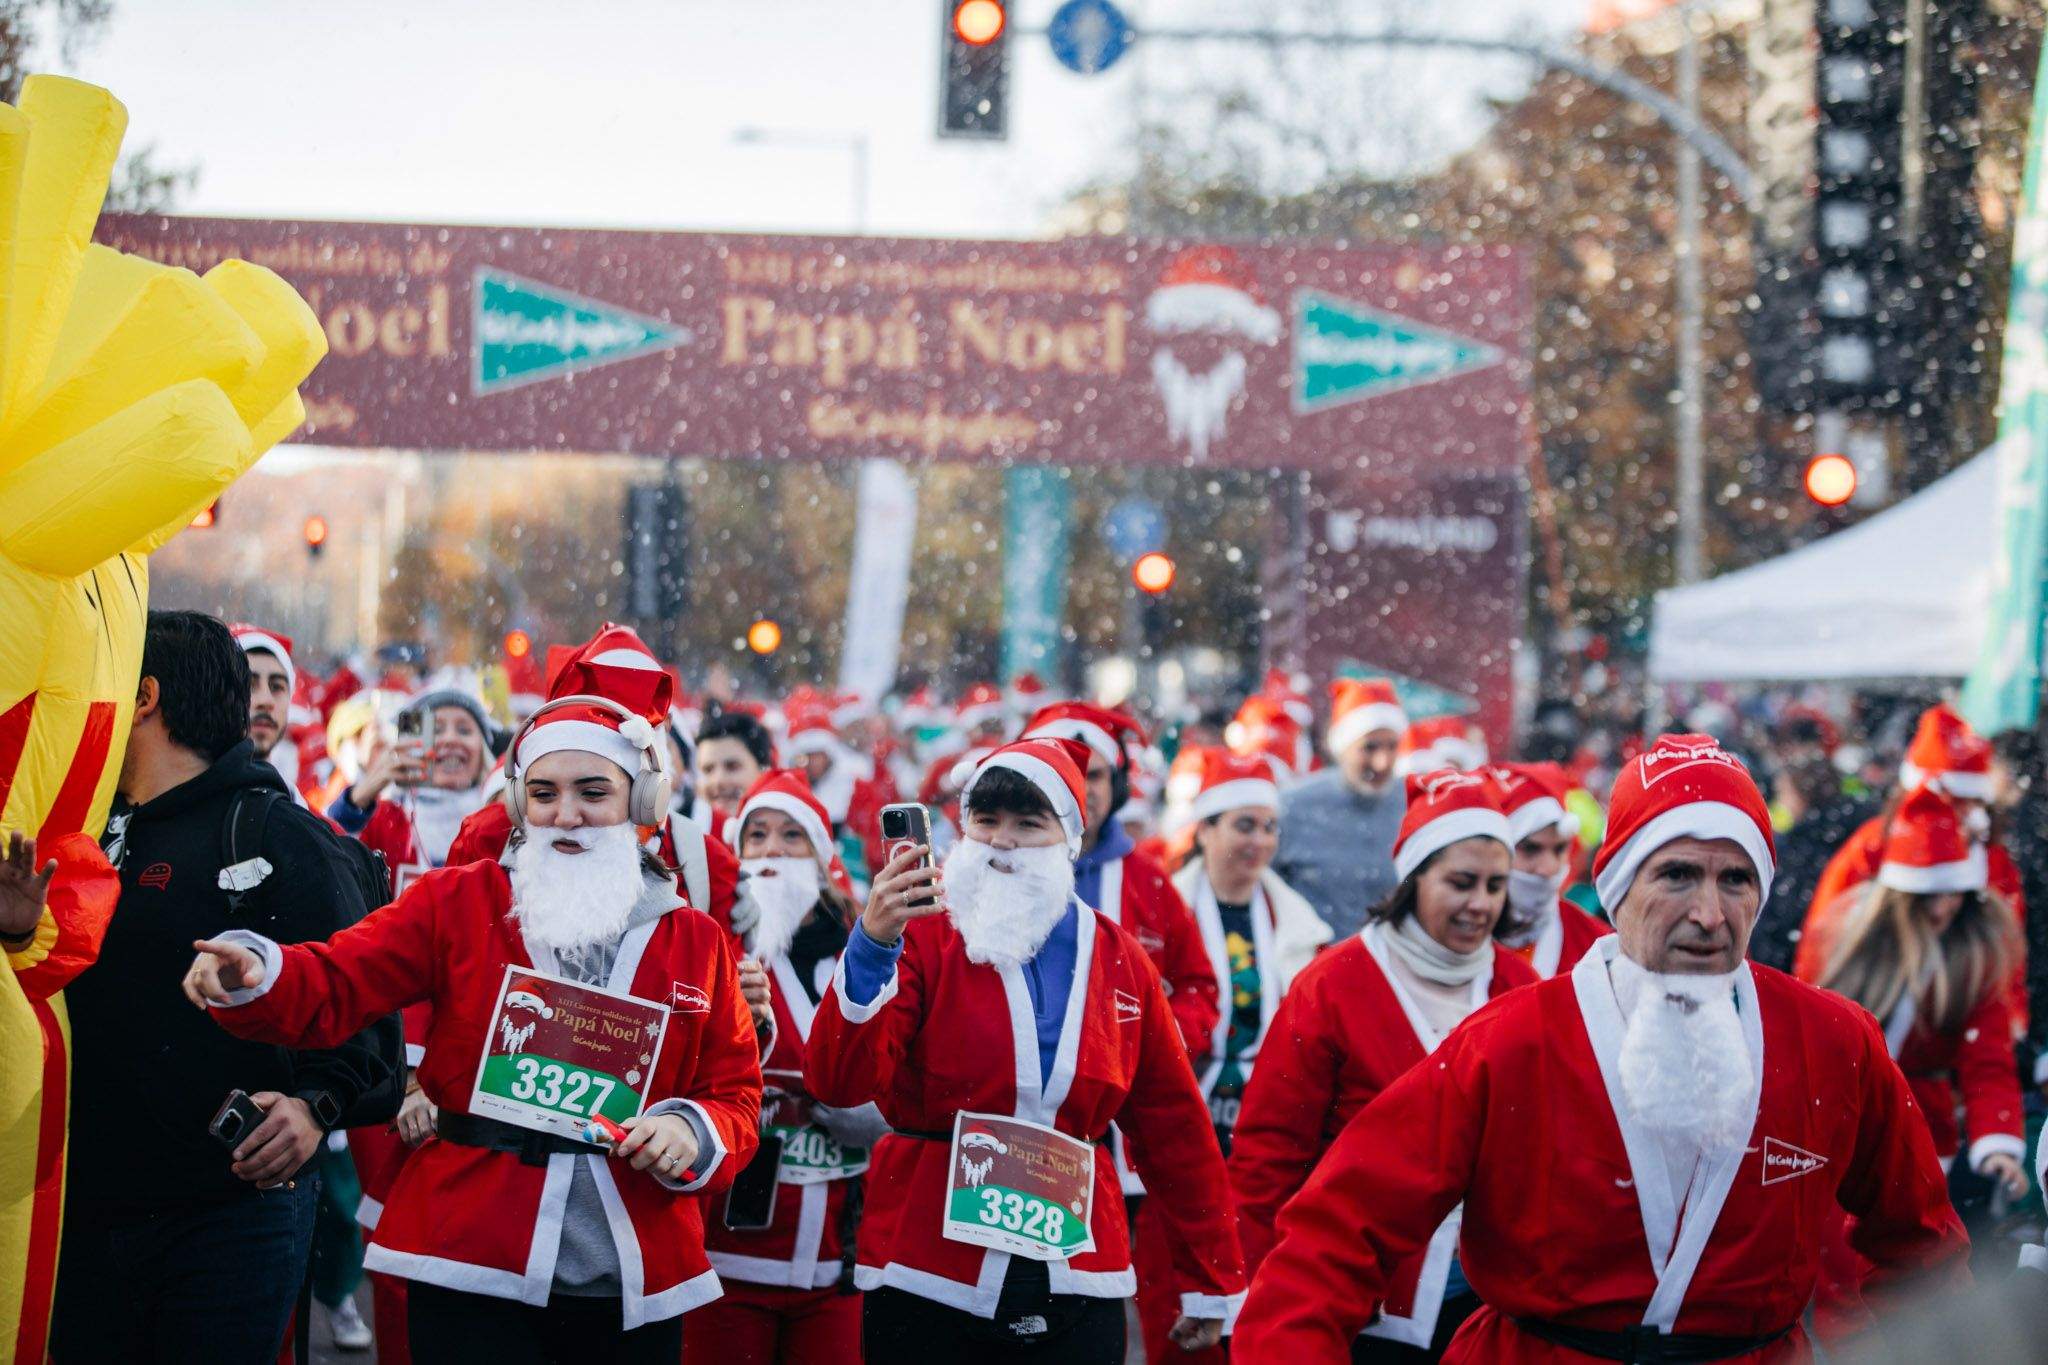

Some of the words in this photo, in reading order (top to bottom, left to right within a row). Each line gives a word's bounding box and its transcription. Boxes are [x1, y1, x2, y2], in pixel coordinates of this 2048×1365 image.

[308, 284, 452, 358] oel
[720, 296, 920, 389] Papá
[948, 299, 1128, 374] Noel
[552, 1006, 597, 1033] Papá
[601, 1019, 641, 1044] Noel
[574, 1002, 601, 1015] Carrera
[633, 1017, 643, 1026] de
[511, 1058, 616, 1116] 3327
[1007, 1143, 1044, 1166] Papá
[1048, 1154, 1078, 1178] Noel
[979, 1188, 1065, 1245] 3328
